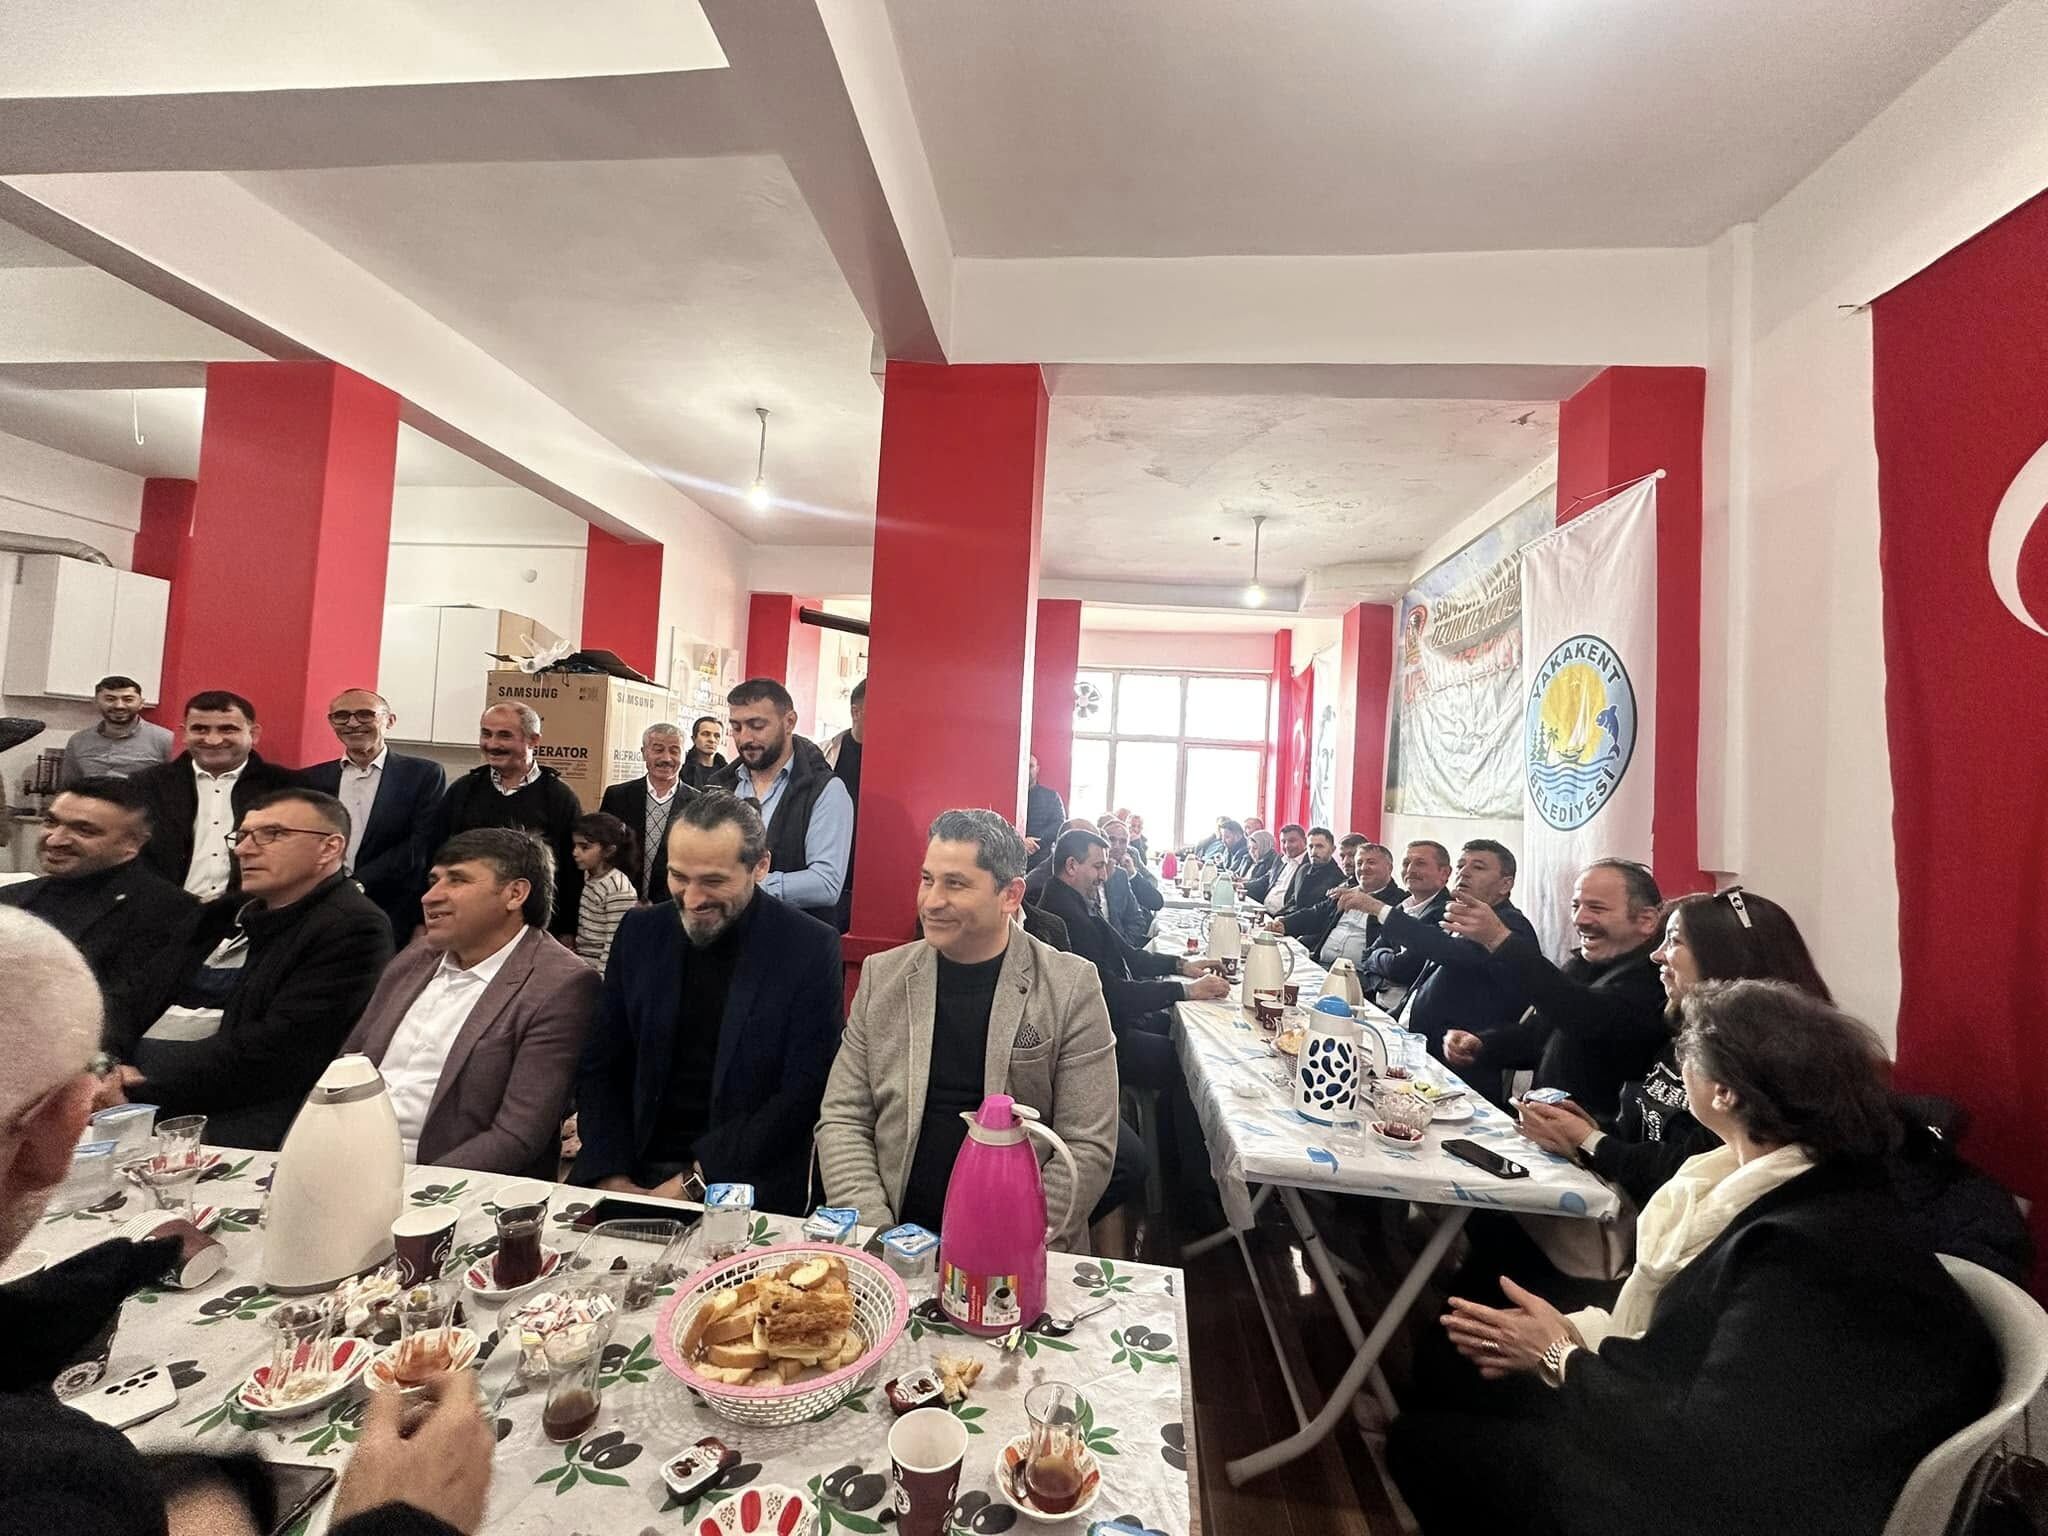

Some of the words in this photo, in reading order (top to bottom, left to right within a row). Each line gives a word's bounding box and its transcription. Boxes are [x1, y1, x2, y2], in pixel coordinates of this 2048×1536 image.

[1532, 641, 1621, 699] YAKAKENT
[498, 686, 558, 699] SAMSUNG
[616, 692, 655, 709] SAMSUNG
[532, 745, 589, 760] GERATOR
[1529, 764, 1616, 823] BELEDİYESİ
